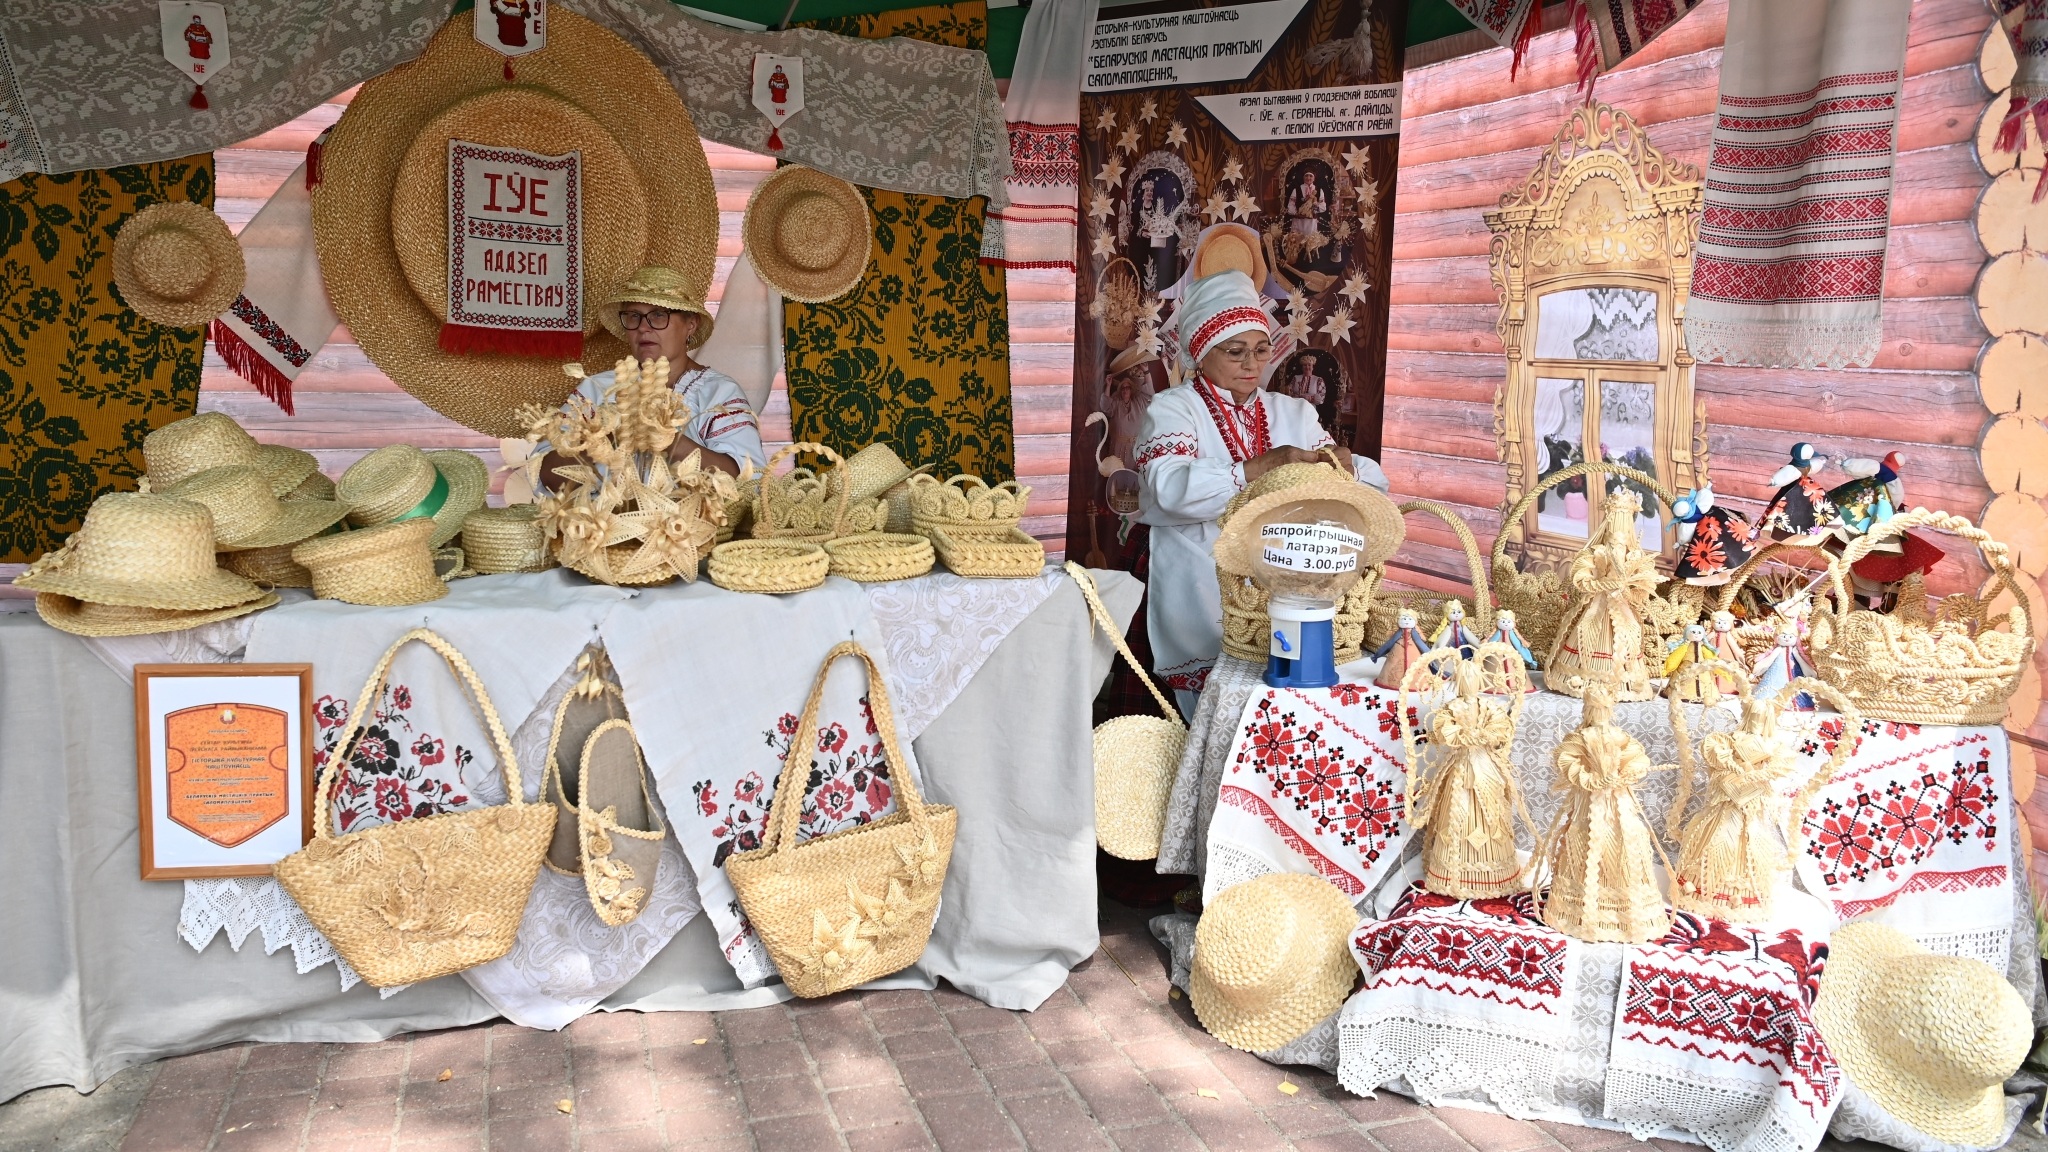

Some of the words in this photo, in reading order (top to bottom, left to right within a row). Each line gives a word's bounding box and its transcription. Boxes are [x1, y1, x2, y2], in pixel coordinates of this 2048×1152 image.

[1094, 16, 1179, 36] ІСТОРЫКА-КУЛЬТУРНАЯ
[1182, 9, 1240, 26] КАШТОЎНАСЦЬ
[1131, 31, 1168, 46] БЕЛАРУСЬ
[1151, 45, 1208, 63] МАСТАЦКІЯ
[1212, 39, 1263, 58] ПРАКТЫКІ
[1239, 97, 1261, 107] АРЭАЛ
[1263, 94, 1302, 106] БЫТАВАННЯ
[1304, 92, 1310, 103] Ў
[1313, 89, 1361, 103] ГРОДЗЕНСКАЙ
[1285, 122, 1315, 135] ЛЕЛЮКІ
[1318, 120, 1364, 133] ІЎЕЎСКАГА
[1367, 117, 1393, 131] РАЁНА
[483, 171, 549, 217] ІЎЕ
[484, 248, 547, 276] АДДЗЕЛ
[466, 278, 564, 308] РАМЁСТВАЎ
[1261, 525, 1363, 548] Бяспройгрышная
[1286, 540, 1338, 555] латарэя
[1263, 549, 1293, 566] Цана
[1303, 556, 1355, 571] 3.00.руб
